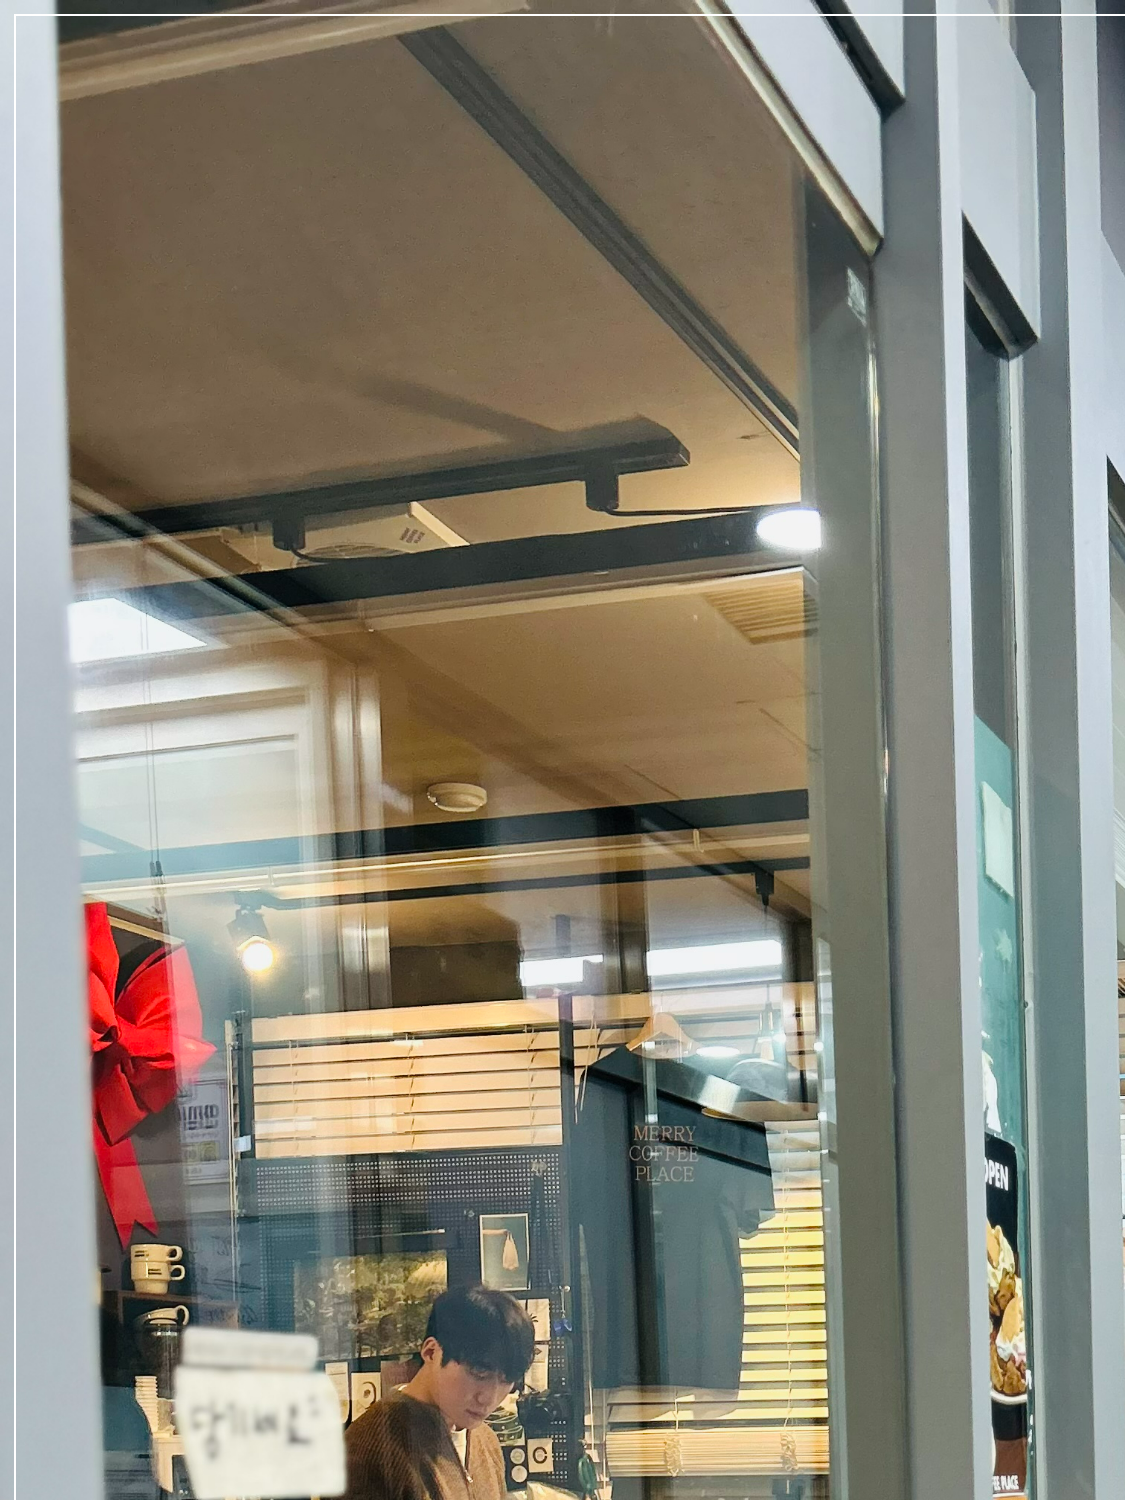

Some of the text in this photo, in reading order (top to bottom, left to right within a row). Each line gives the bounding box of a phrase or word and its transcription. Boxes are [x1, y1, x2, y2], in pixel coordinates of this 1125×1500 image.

[633, 1125, 697, 1142] MERRY
[629, 1145, 700, 1162] COFFEE
[634, 1165, 695, 1182] PLACE
[985, 1157, 1009, 1191] OPEN
[1001, 1474, 1019, 1491] PLACE
